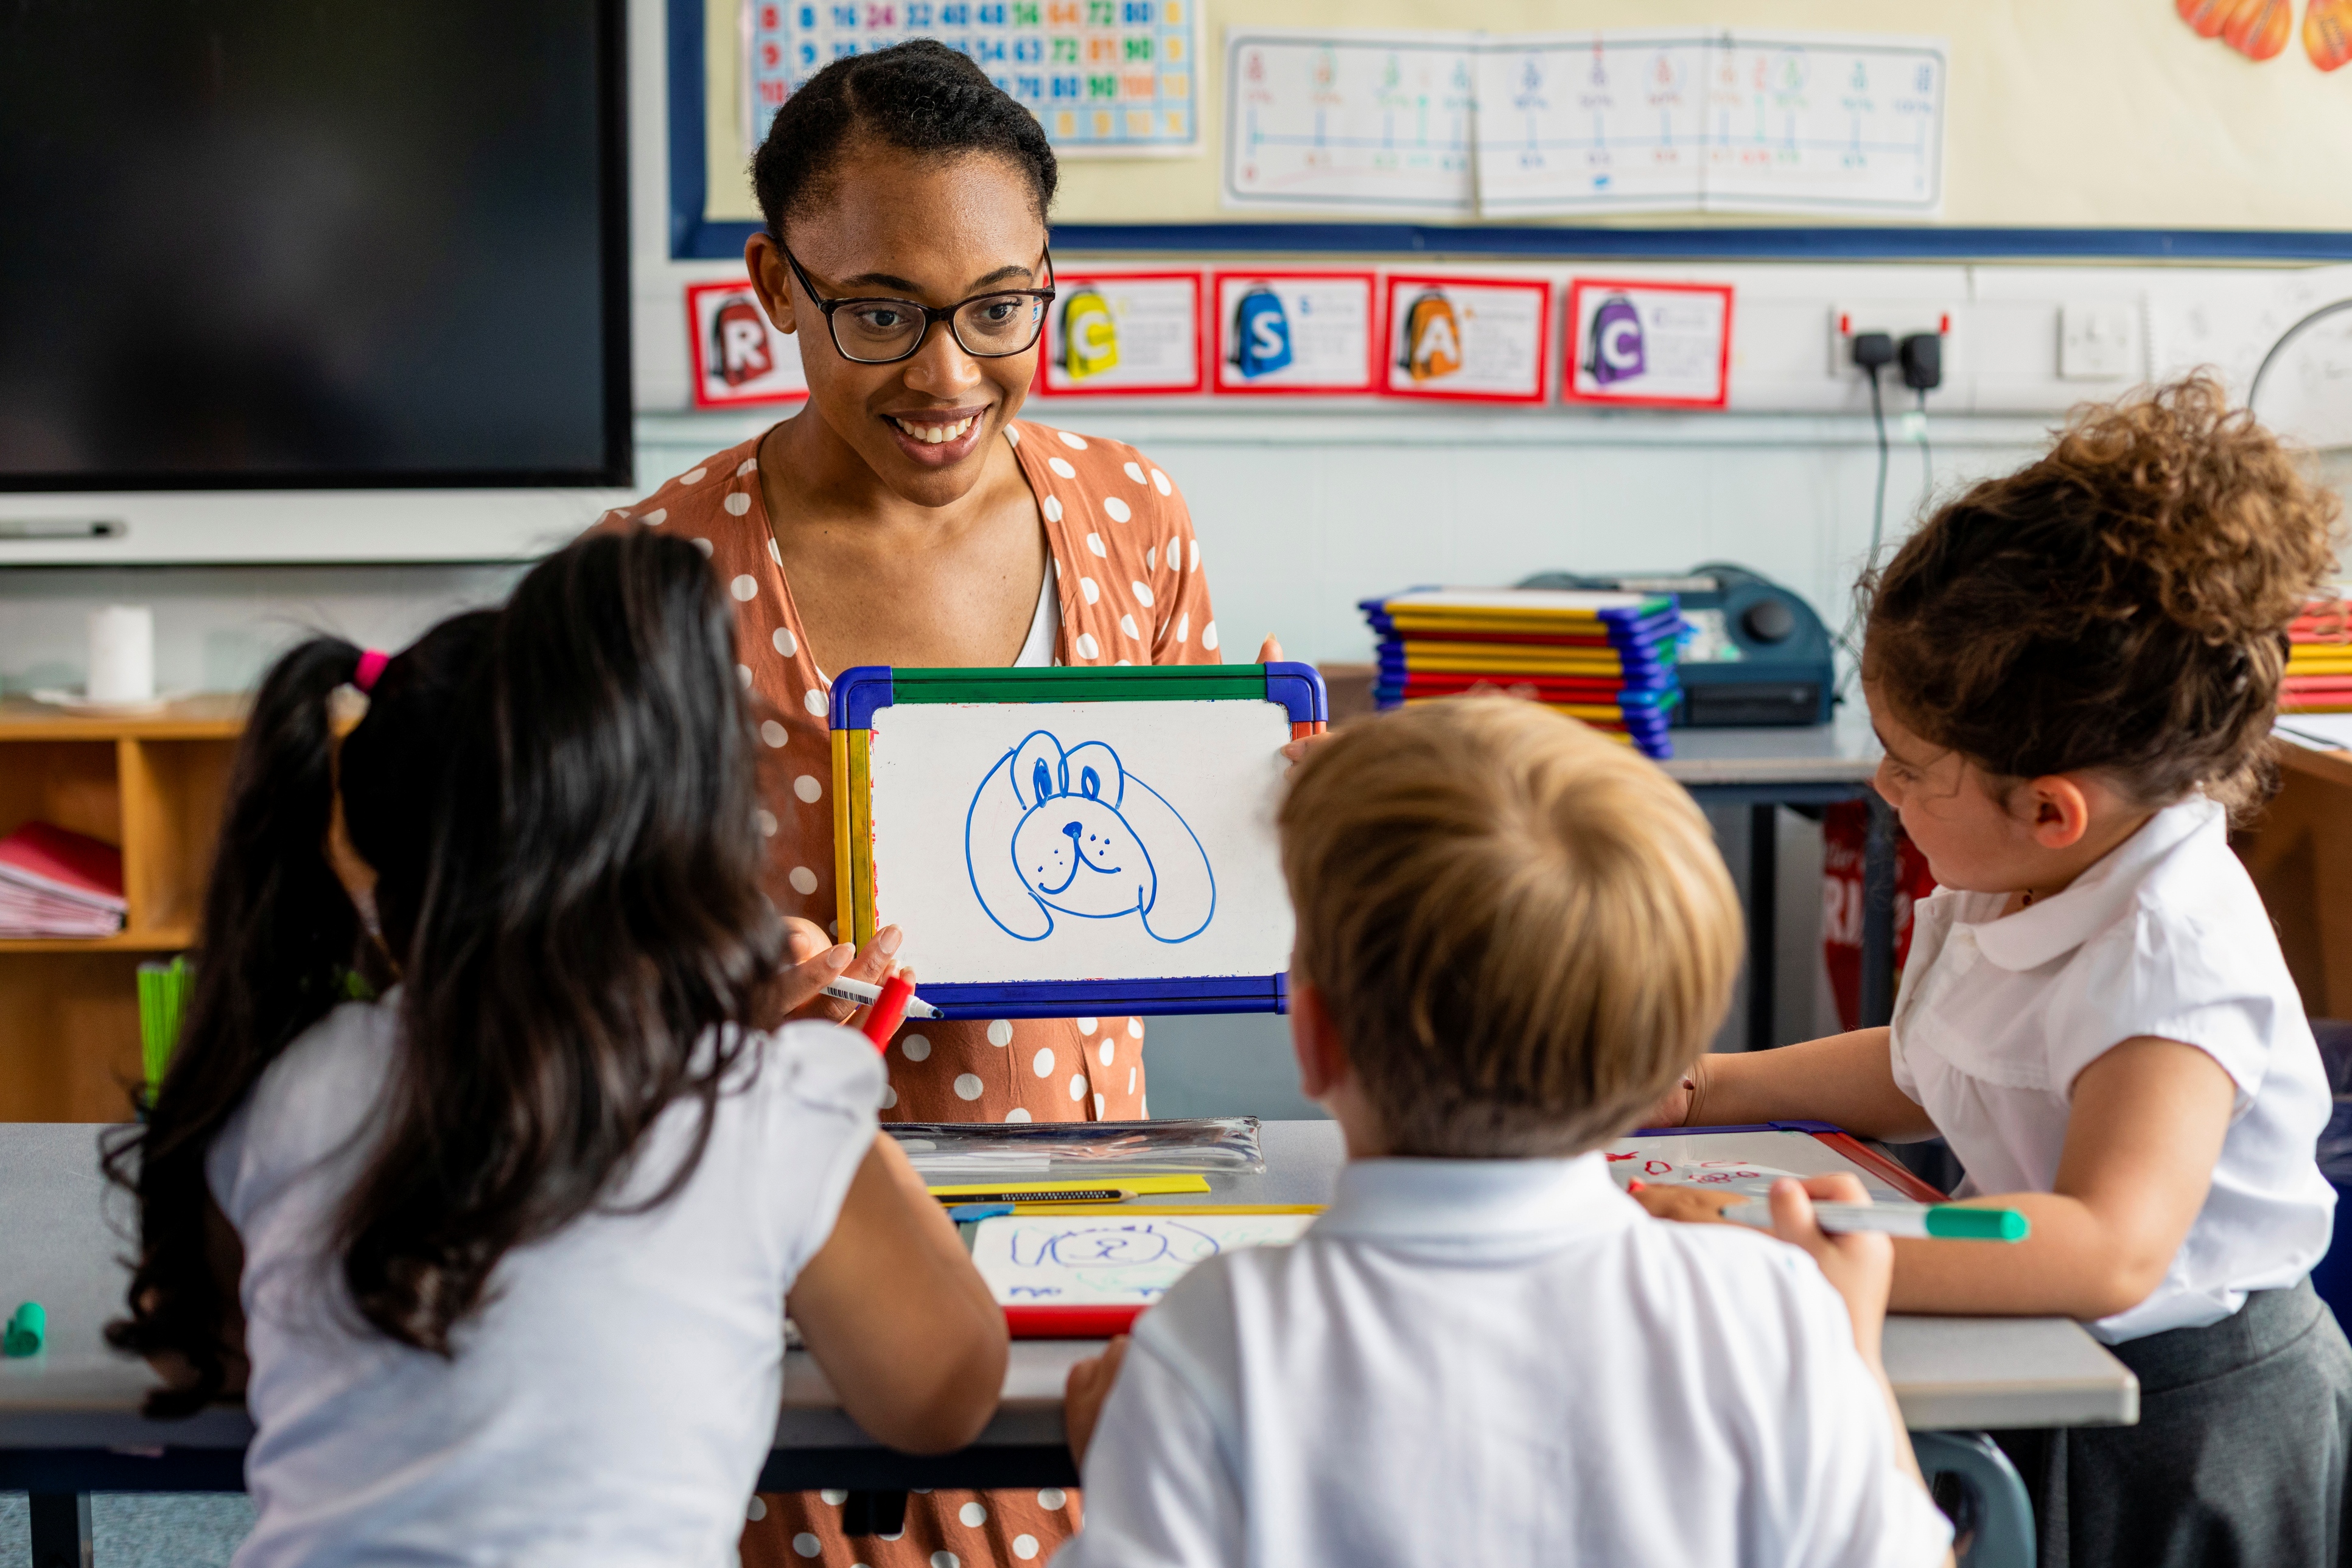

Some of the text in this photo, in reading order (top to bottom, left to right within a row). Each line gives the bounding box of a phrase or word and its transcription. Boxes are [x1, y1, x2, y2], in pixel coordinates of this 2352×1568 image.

[761, 4, 779, 31] 8
[799, 5, 814, 29] 8
[867, 3, 894, 29] 24
[906, 4, 930, 27] 32
[979, 4, 1003, 26] 48
[1013, 2, 1039, 27] 56
[1048, 2, 1077, 26] 64
[1088, 0, 1113, 26] 72
[1124, 1, 1152, 23] 80
[761, 41, 780, 69] 9
[799, 41, 816, 66] 9
[977, 38, 1003, 61] 54
[1051, 38, 1079, 63] 72
[1126, 38, 1152, 61] 90
[1165, 37, 1183, 61] 9
[1051, 77, 1079, 99] 80
[1088, 76, 1115, 100] 90
[724, 319, 766, 370] R
[1073, 310, 1111, 360] C
[1250, 310, 1284, 359] S
[1416, 316, 1457, 365] A
[1601, 318, 1639, 368] C
